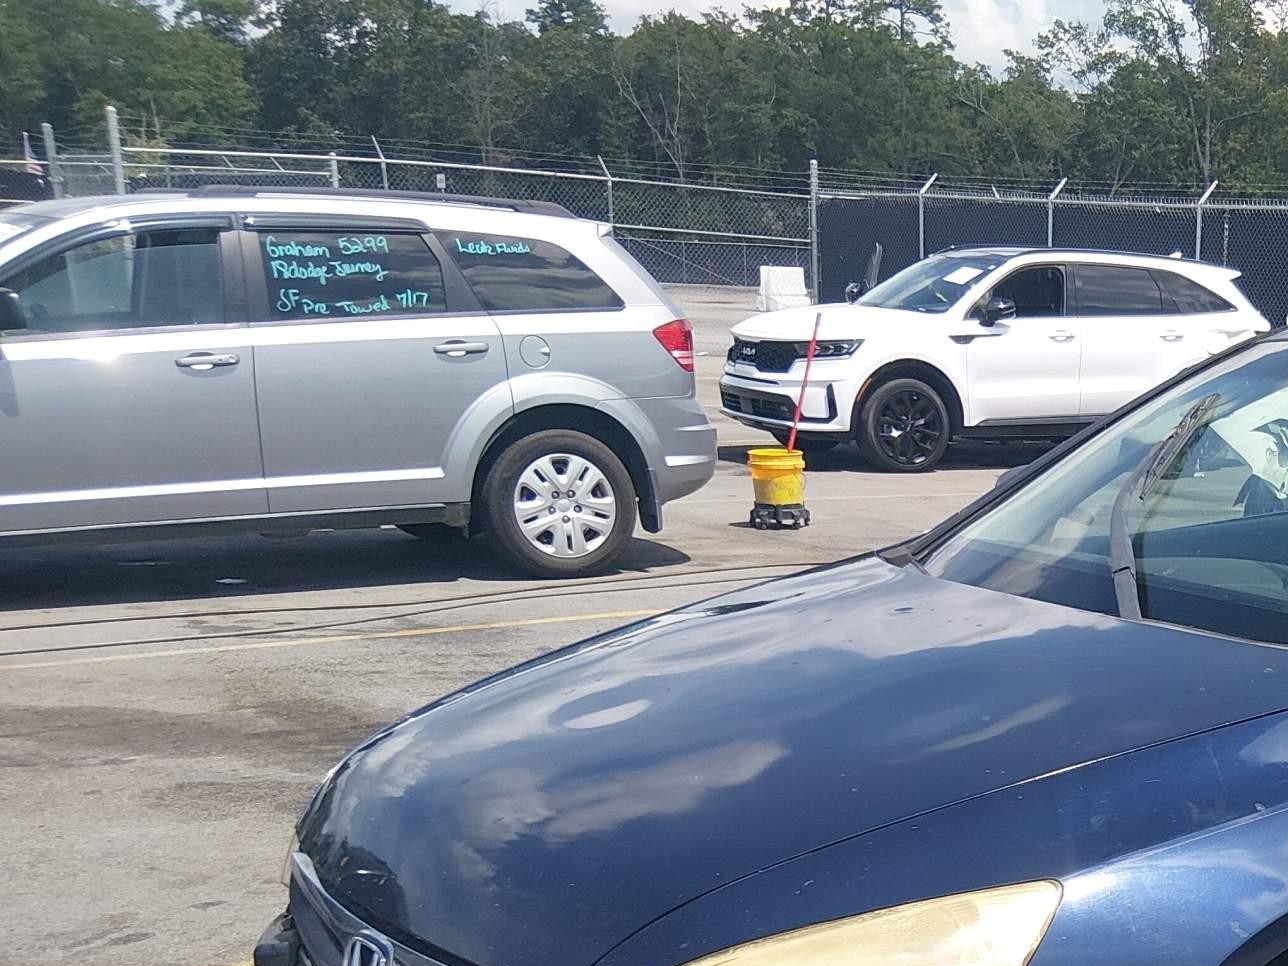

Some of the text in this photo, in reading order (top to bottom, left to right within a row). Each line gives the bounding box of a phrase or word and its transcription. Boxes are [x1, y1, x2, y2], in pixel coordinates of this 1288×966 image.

[266, 236, 389, 258] Graham 5299
[301, 299, 330, 314] Pre
[336, 295, 391, 314] Towed
[396, 290, 429, 308] 7/17
